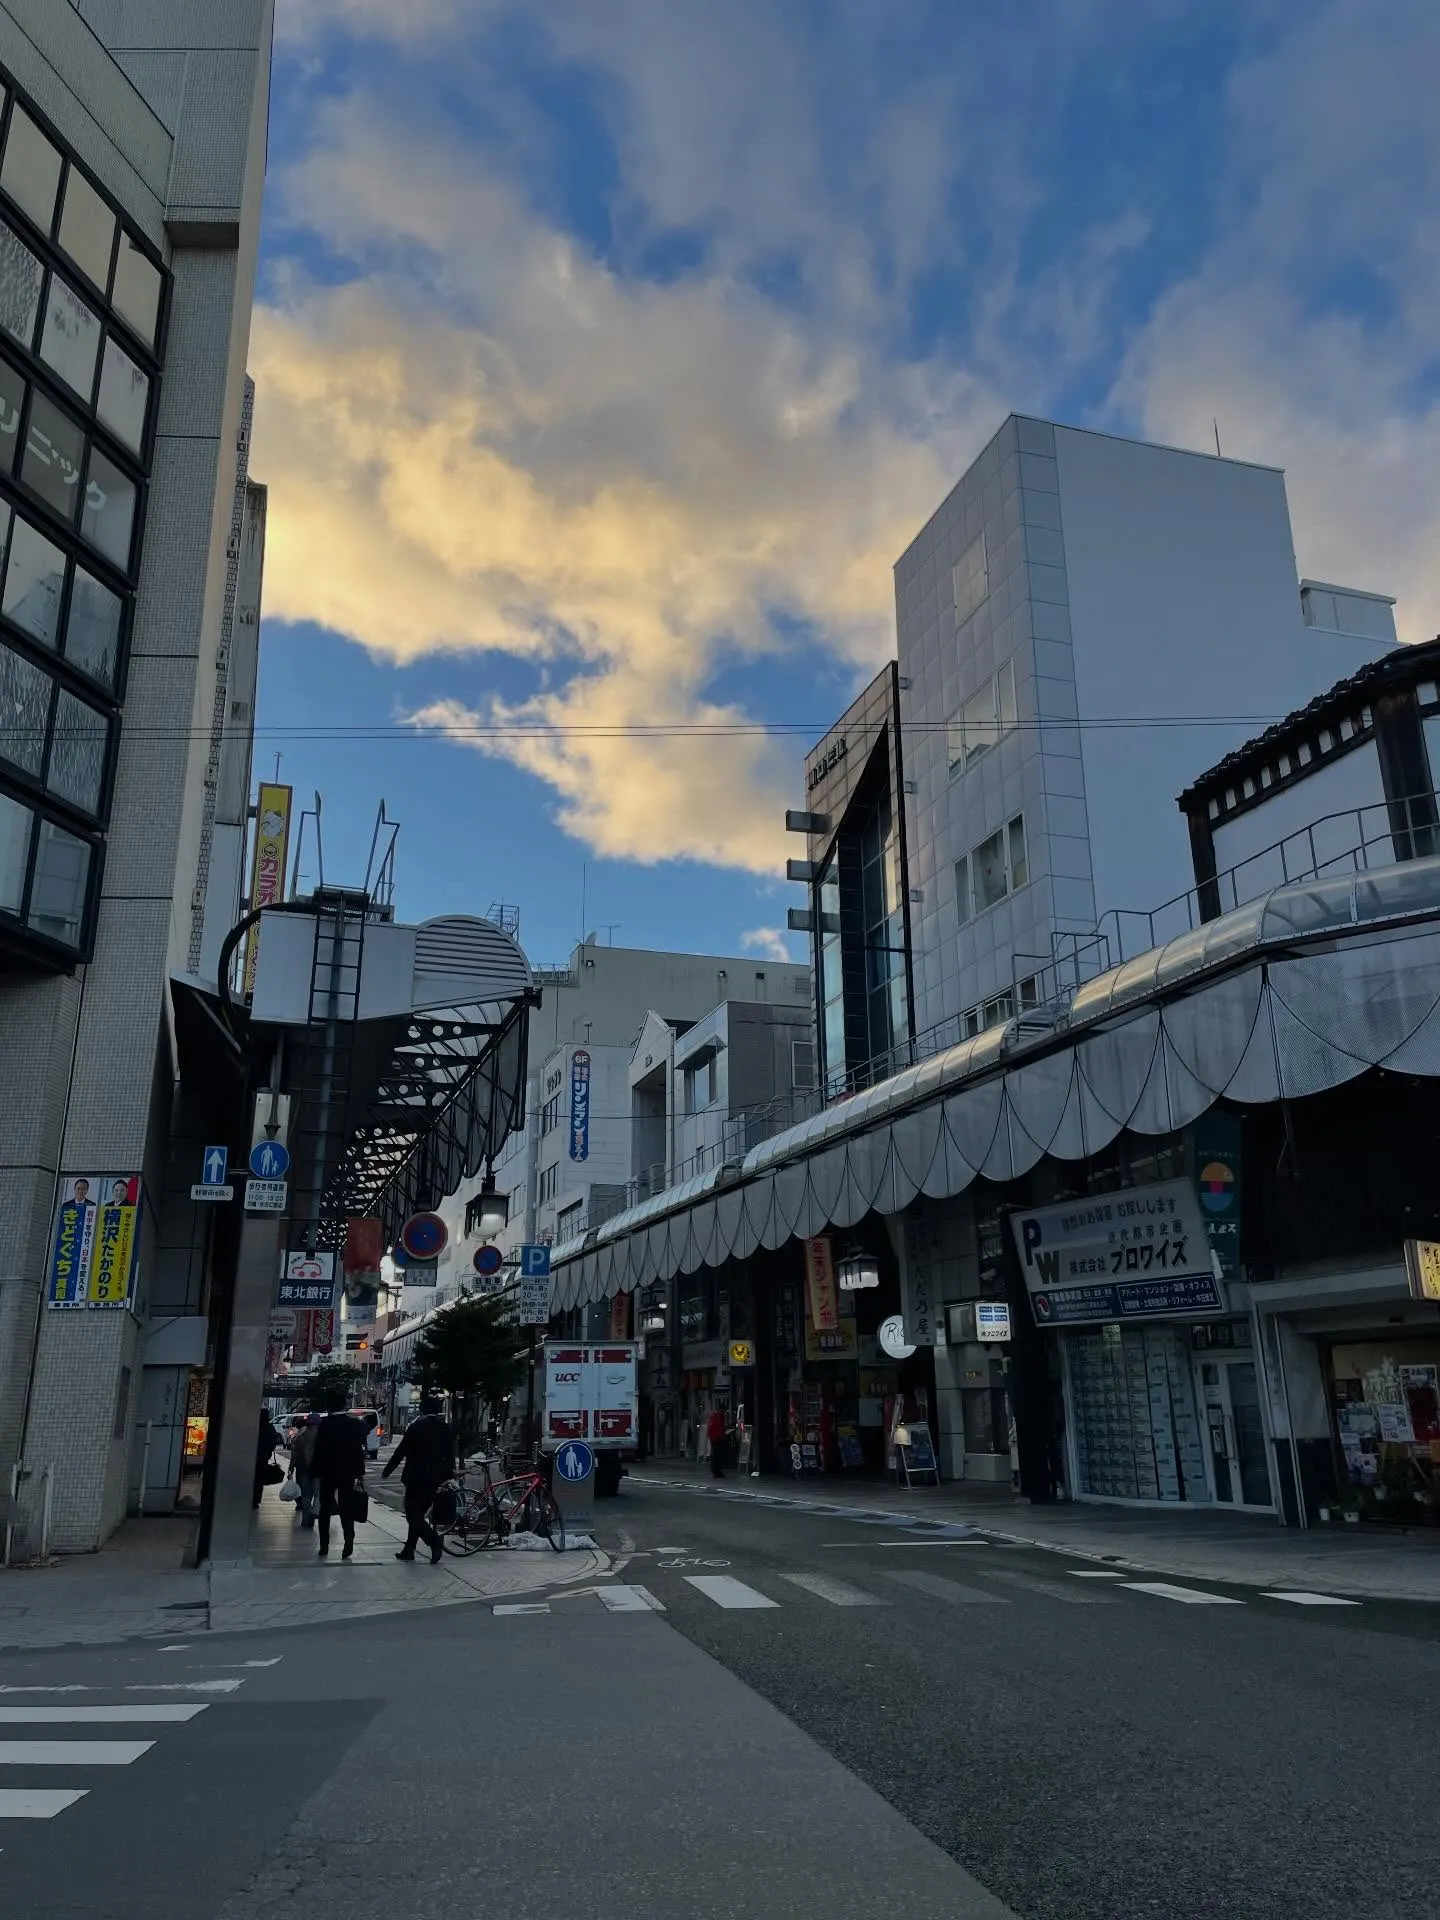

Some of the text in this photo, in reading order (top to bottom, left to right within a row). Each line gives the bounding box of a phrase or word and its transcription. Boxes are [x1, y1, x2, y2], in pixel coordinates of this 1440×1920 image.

[575, 1055, 588, 1064] 6F
[98, 1208, 122, 1299] 横沢たかのり
[529, 1248, 546, 1273] P
[1022, 1219, 1043, 1267] P
[1070, 1235, 1188, 1275] 株式会社 プロワイズ
[1035, 1250, 1060, 1285] W
[280, 1286, 332, 1300] 東北銀行
